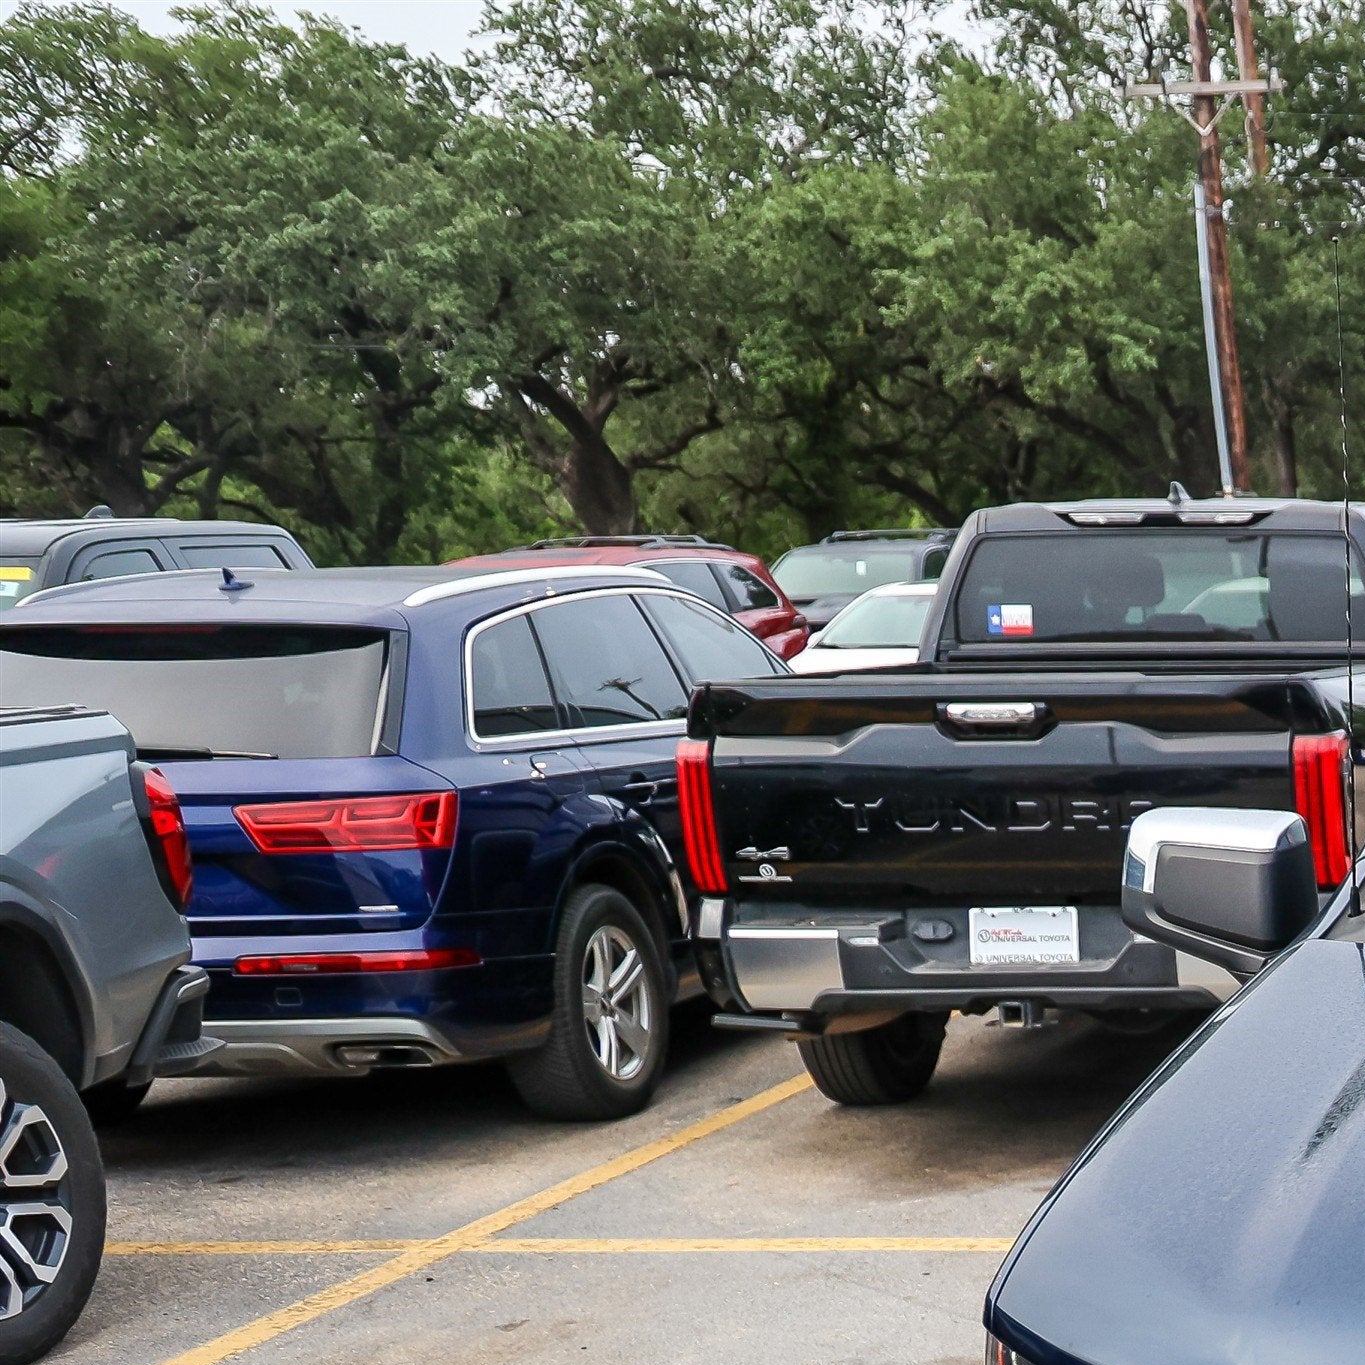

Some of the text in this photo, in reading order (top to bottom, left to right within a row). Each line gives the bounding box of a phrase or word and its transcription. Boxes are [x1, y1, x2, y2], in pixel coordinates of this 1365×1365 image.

[991, 935, 1037, 943] UNIVERSAL
[1040, 934, 1071, 942] TOYOTA
[985, 953, 1074, 962] UNIVERSAL TOYOTA
